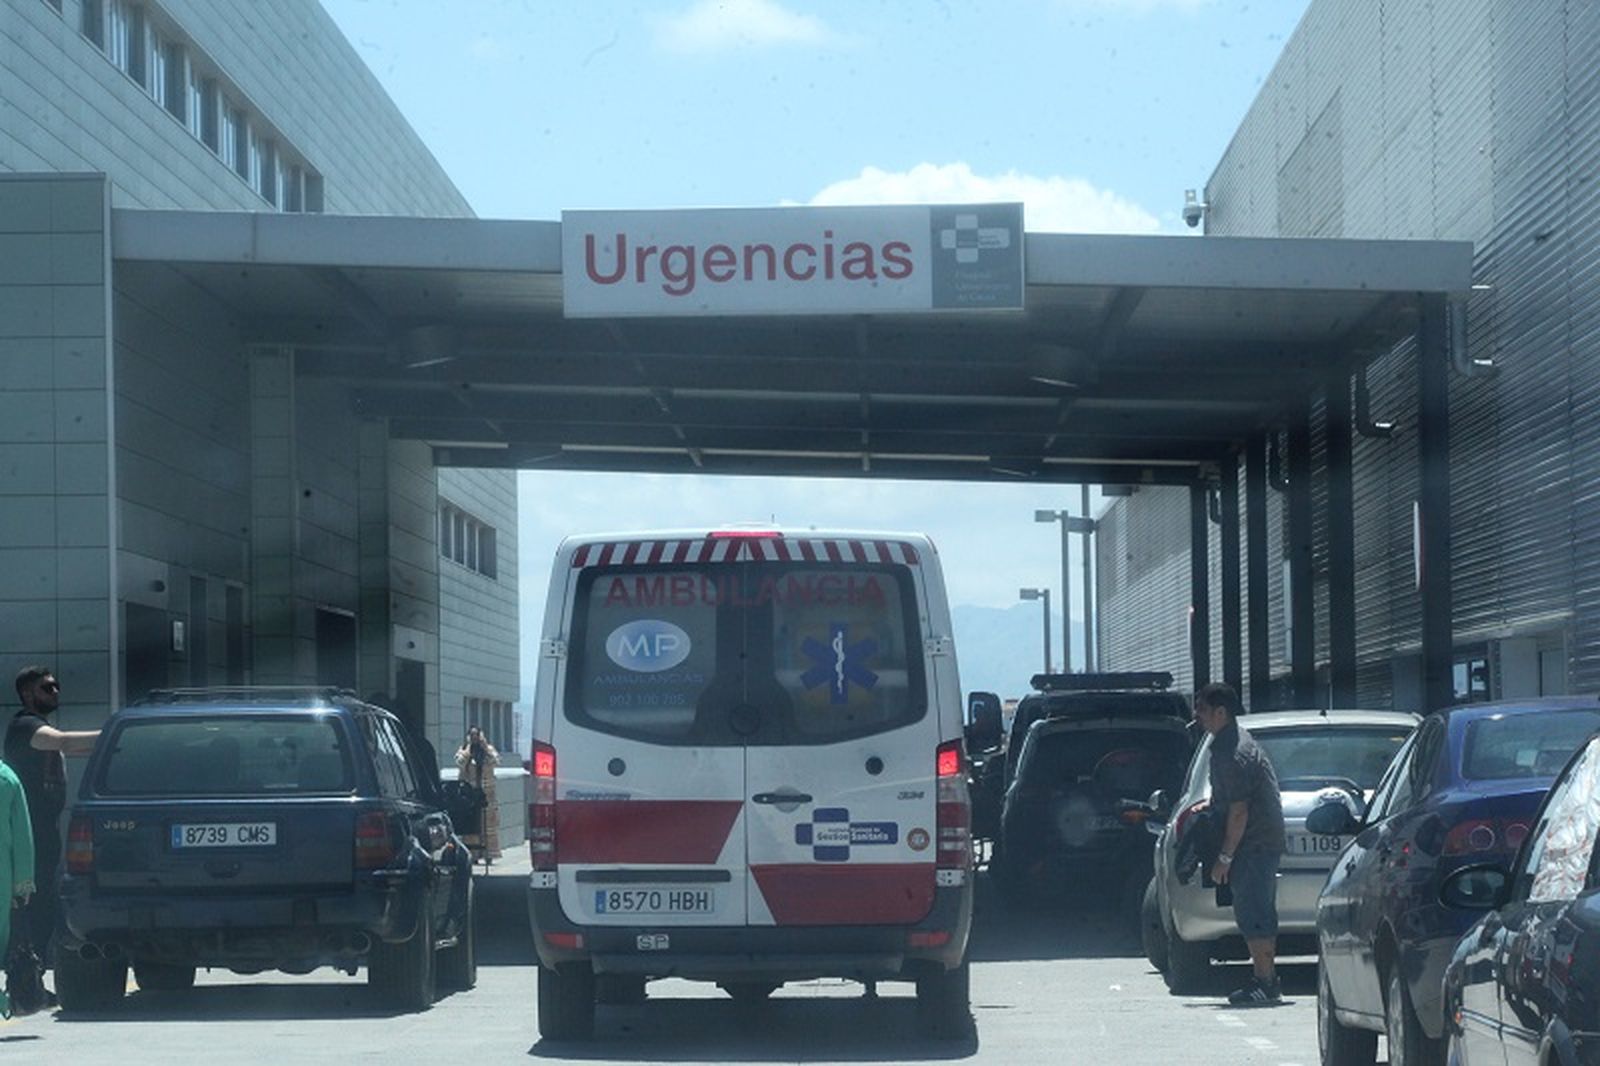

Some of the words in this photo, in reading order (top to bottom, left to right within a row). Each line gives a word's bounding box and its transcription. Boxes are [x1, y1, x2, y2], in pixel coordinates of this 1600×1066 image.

[585, 230, 915, 297] Urgencias
[604, 575, 885, 609] AMBULANCIA
[616, 633, 681, 657] MP
[103, 820, 136, 831] Jeep
[185, 826, 228, 844] 8739
[237, 825, 270, 842] CMS
[1301, 836, 1341, 852] 1109
[609, 891, 661, 911] 8570
[669, 891, 708, 911] HBH
[639, 934, 668, 950] SP
